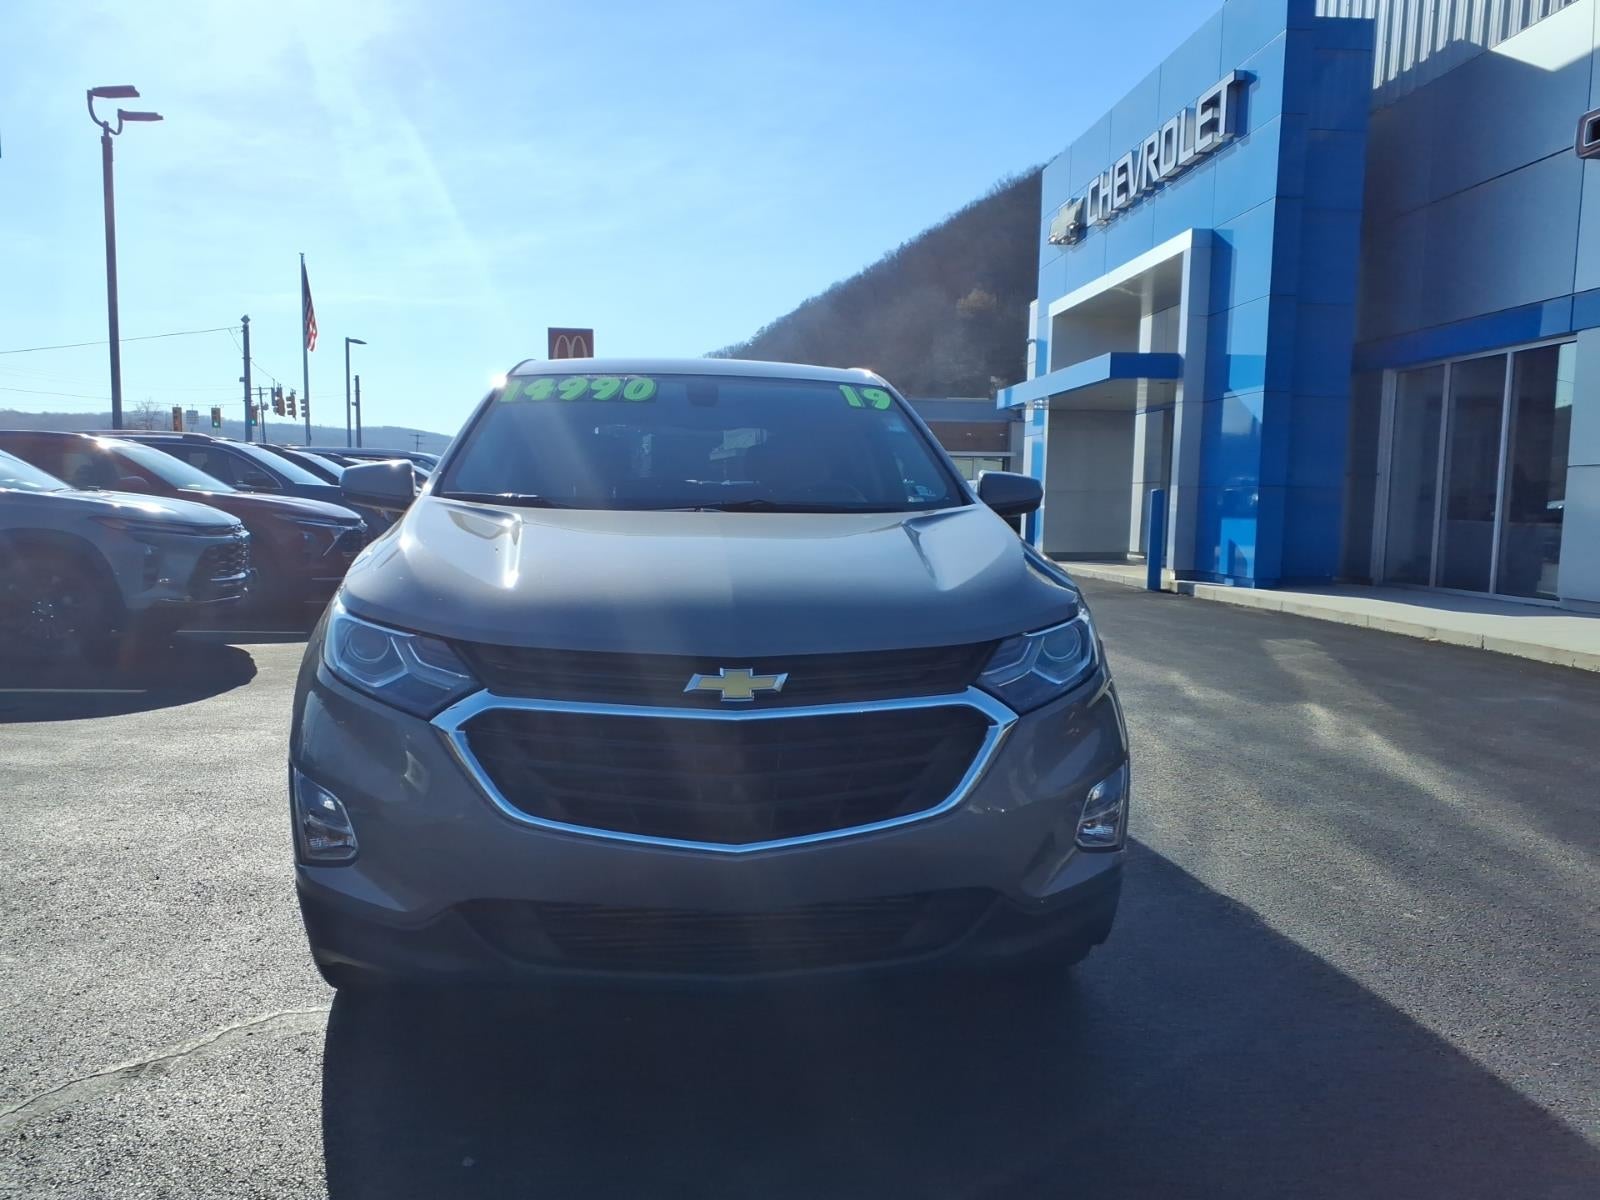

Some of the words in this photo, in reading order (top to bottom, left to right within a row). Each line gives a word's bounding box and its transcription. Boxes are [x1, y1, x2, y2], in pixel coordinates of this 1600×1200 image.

[1086, 69, 1247, 228] CHEVROLET
[501, 376, 657, 402] 14990
[839, 384, 891, 410] 19
